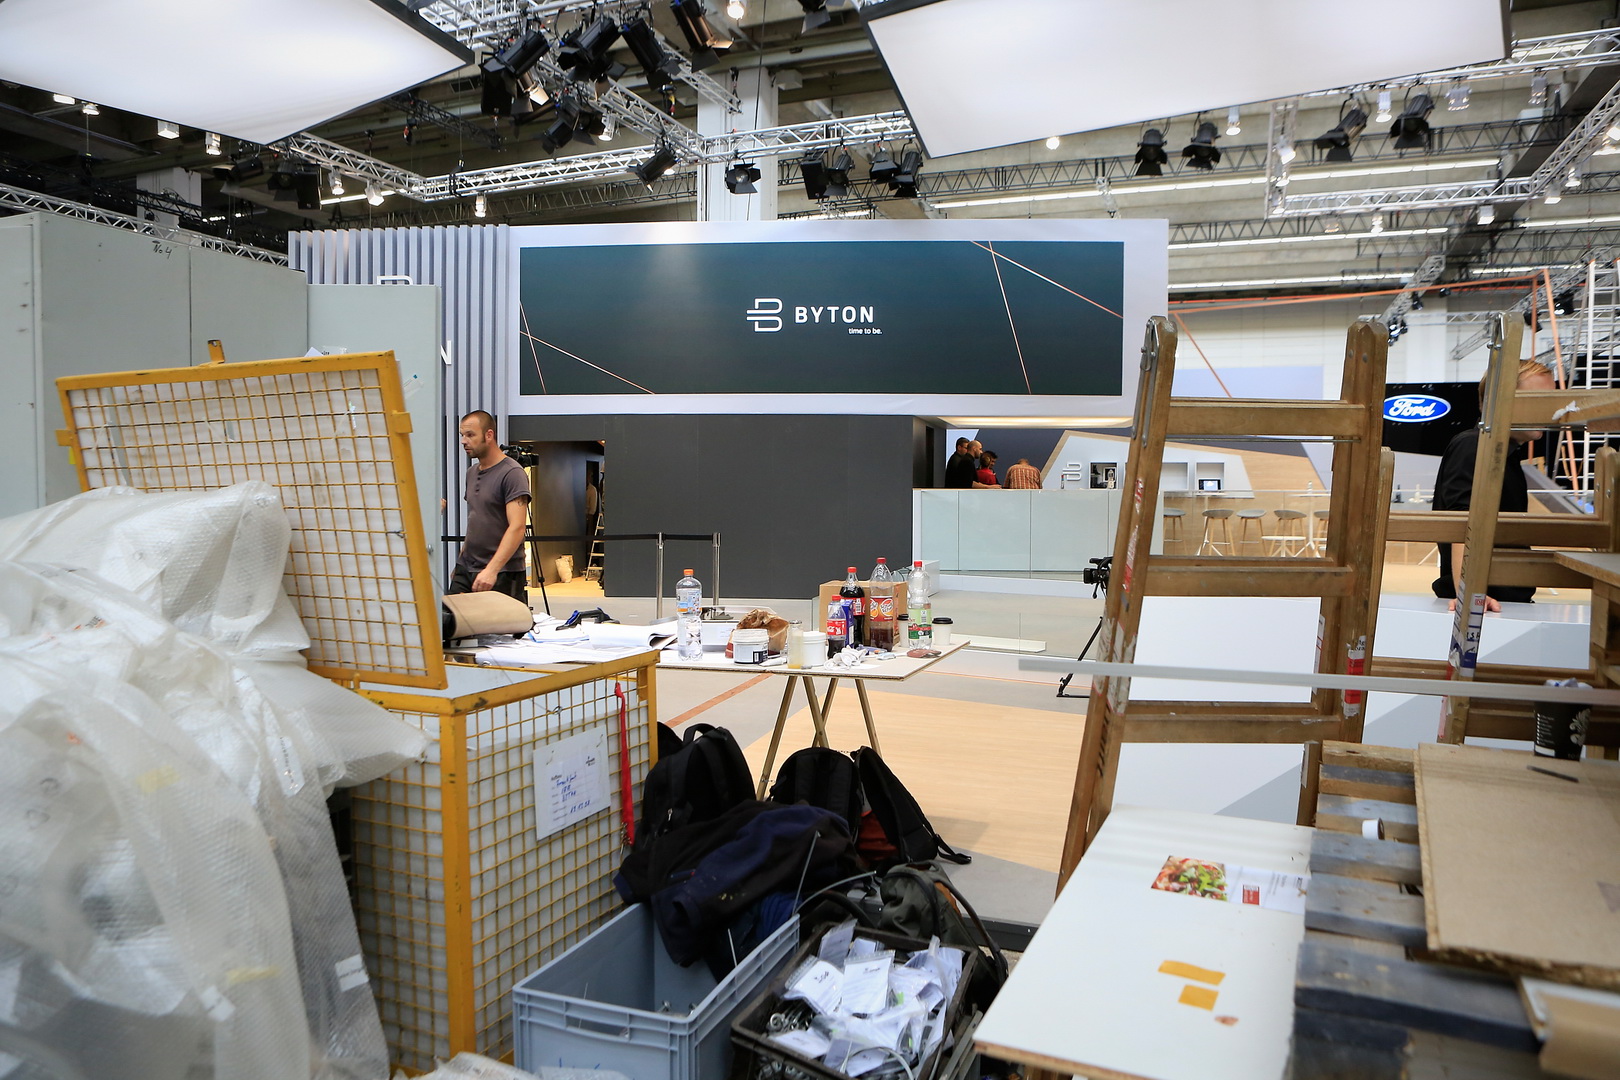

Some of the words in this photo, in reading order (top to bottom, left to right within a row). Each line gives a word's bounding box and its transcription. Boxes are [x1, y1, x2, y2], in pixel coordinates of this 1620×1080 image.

[795, 306, 874, 323] BYTON
[848, 327, 863, 335] time
[864, 327, 872, 335] to
[872, 327, 883, 335] be.
[1388, 398, 1437, 417] Ford
